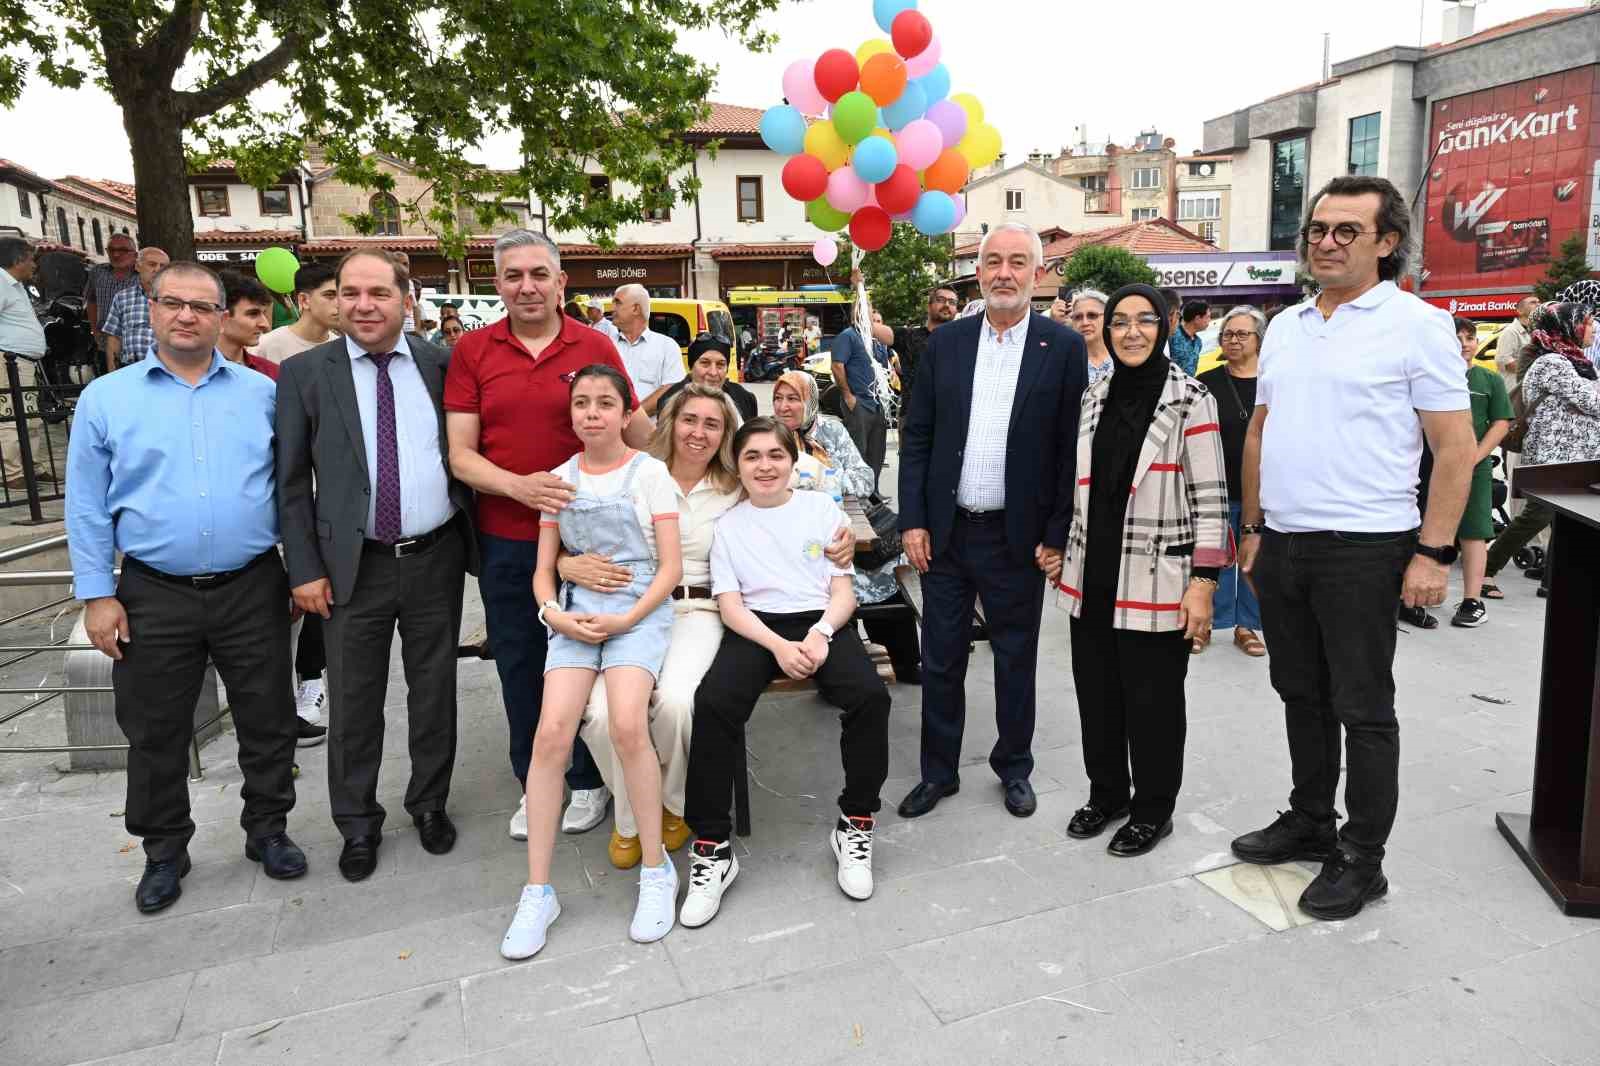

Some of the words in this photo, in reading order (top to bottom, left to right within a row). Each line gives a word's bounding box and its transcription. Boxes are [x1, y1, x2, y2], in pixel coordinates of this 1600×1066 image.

[198, 253, 229, 261] ODEL
[240, 252, 258, 261] SA
[621, 267, 648, 278] DÖNER
[1152, 270, 1218, 286] osense
[1457, 302, 1487, 312] Ziraat
